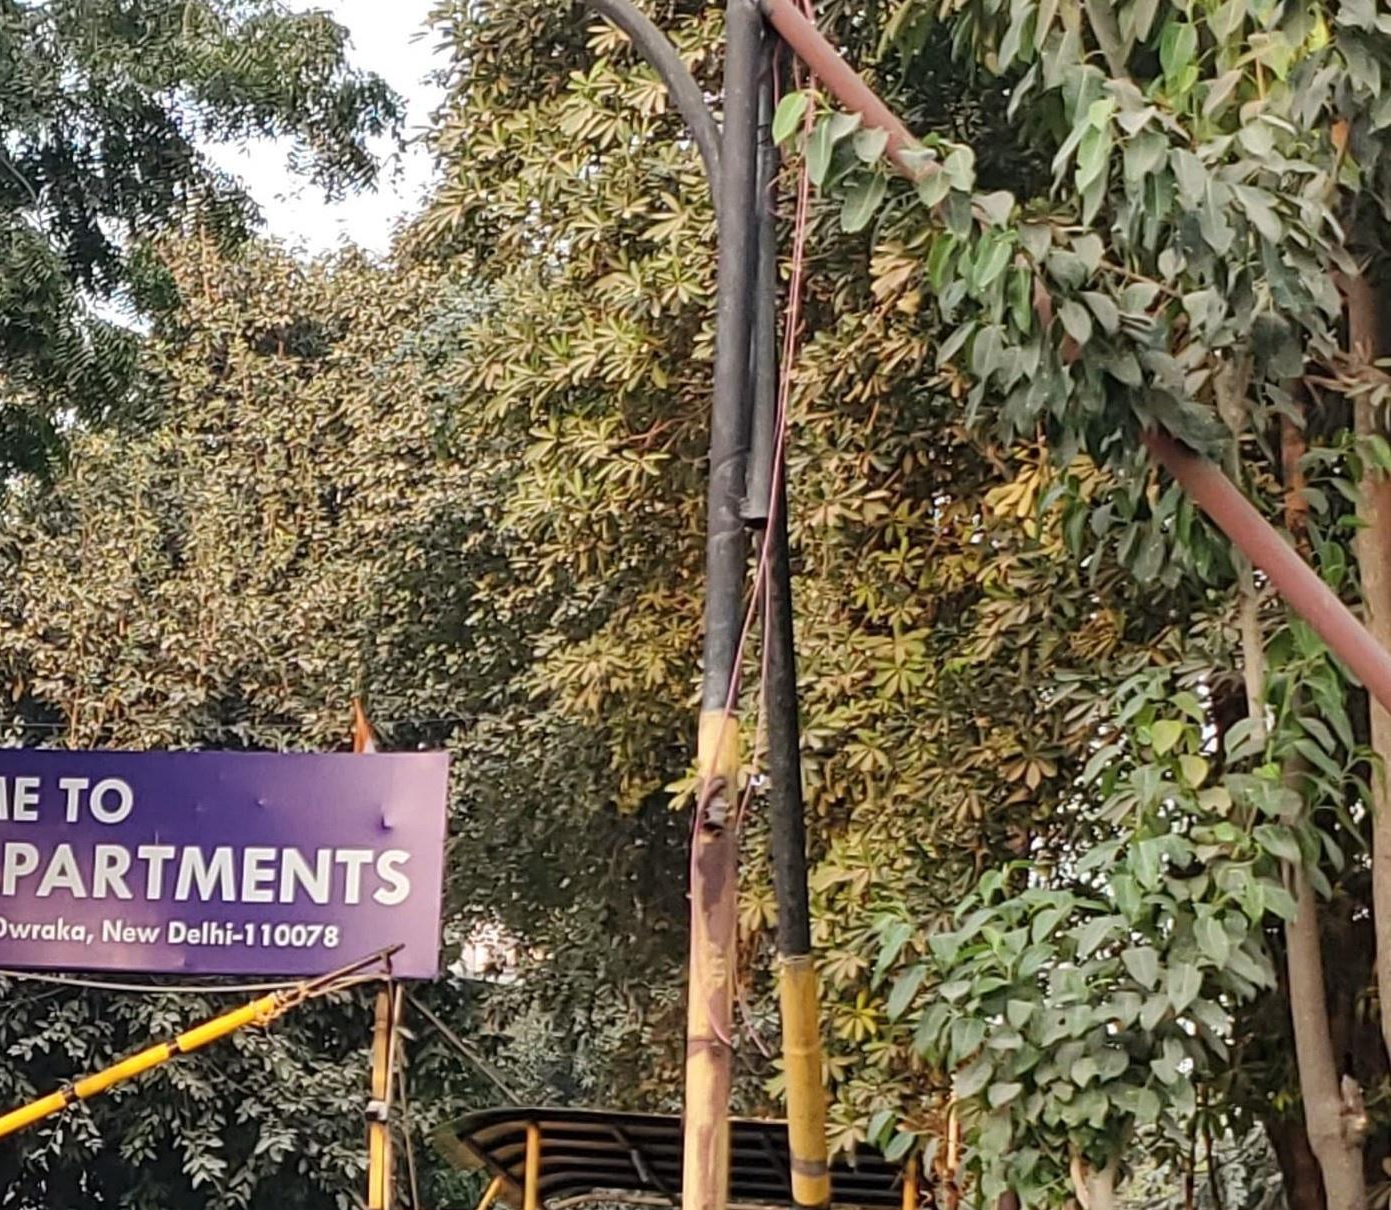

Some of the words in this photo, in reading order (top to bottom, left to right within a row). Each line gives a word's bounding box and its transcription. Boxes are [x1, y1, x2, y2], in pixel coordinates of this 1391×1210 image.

[59, 777, 133, 823] TO
[103, 921, 161, 944] New
[168, 920, 339, 949] Delhi-110078
